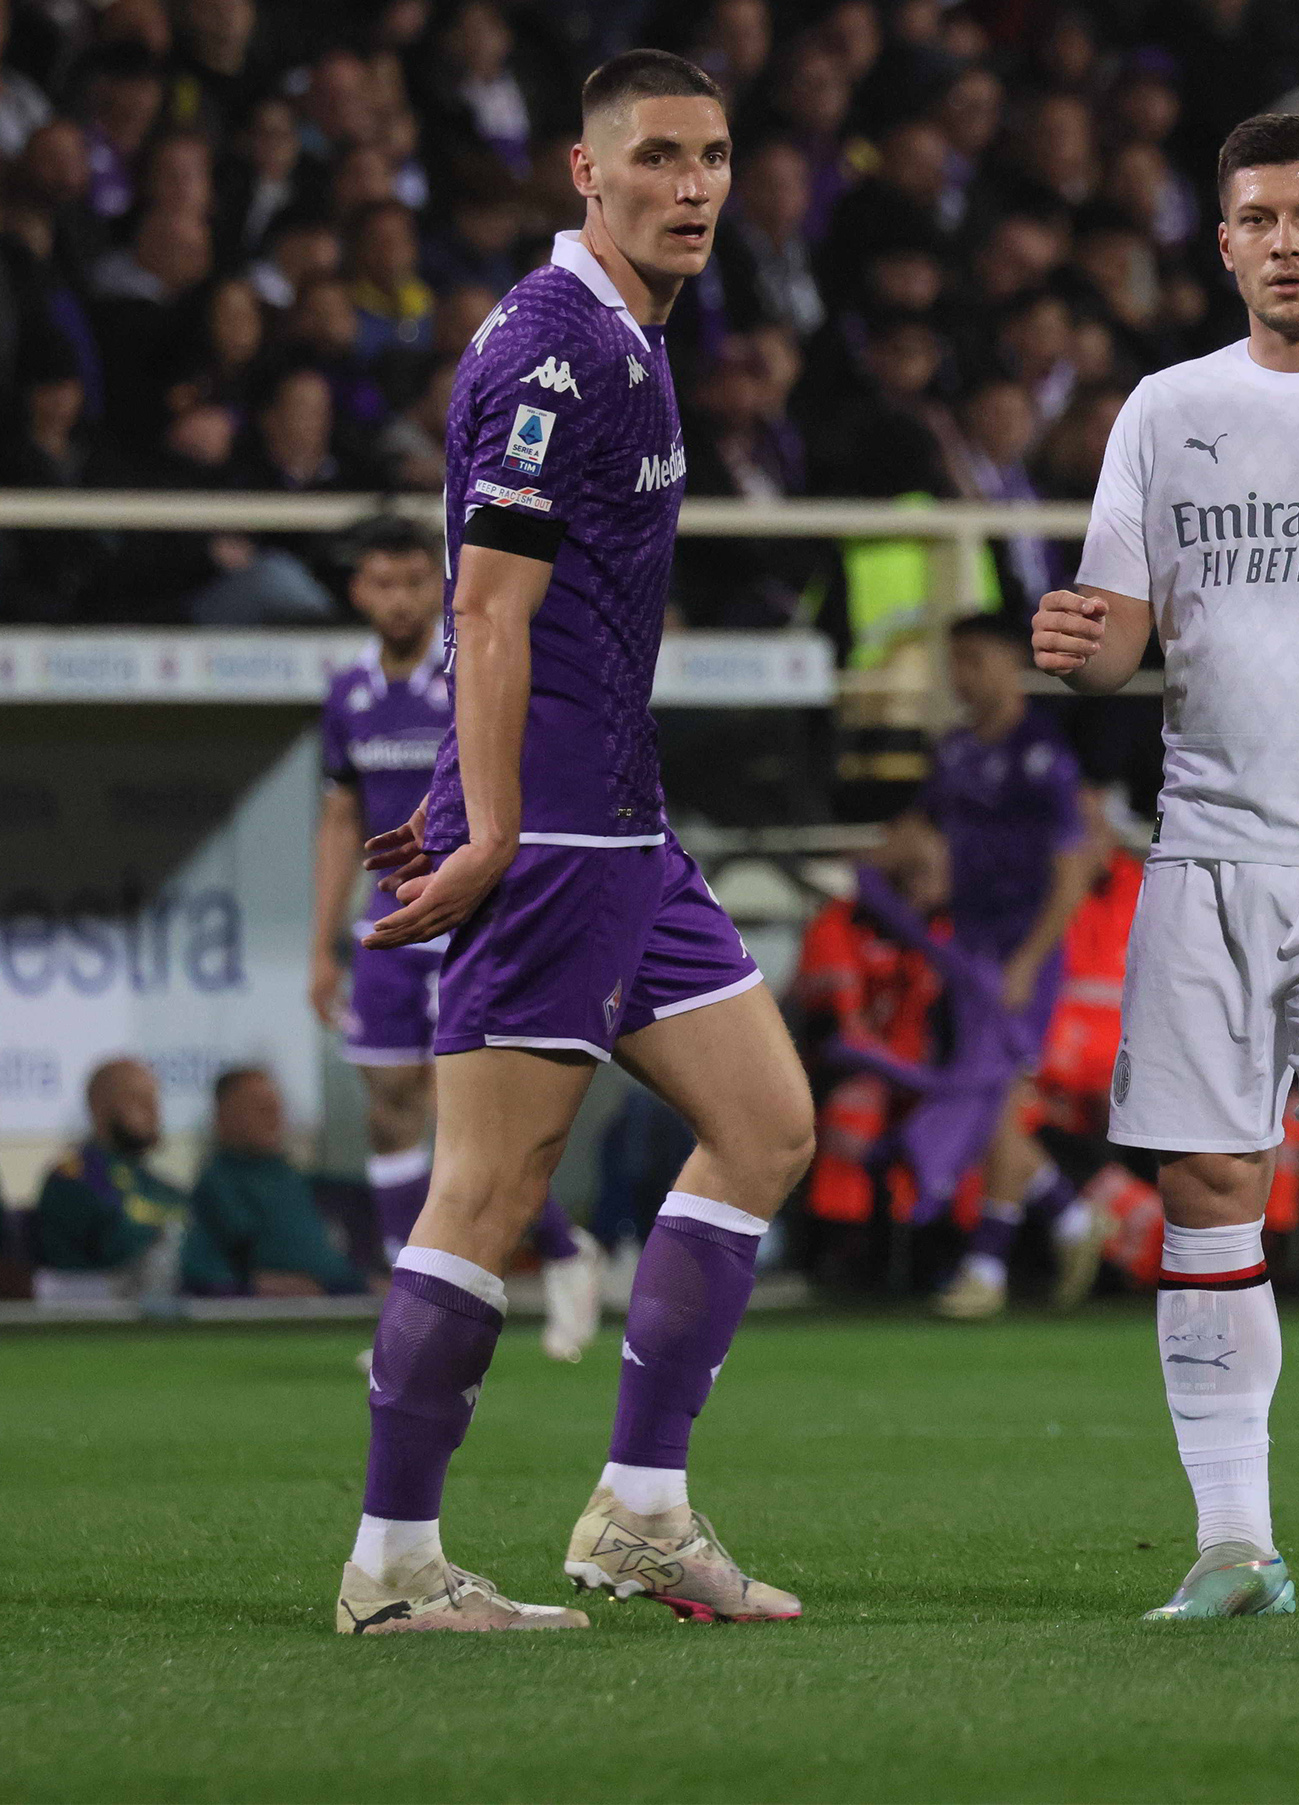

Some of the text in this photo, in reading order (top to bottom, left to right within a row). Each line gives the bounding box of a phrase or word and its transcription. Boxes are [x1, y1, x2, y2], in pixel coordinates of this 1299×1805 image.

[512, 444, 532, 456] SERIE
[519, 460, 537, 473] TIM
[477, 480, 551, 510] KEEP RACISM OUT
[1201, 548, 1239, 589] FLY
